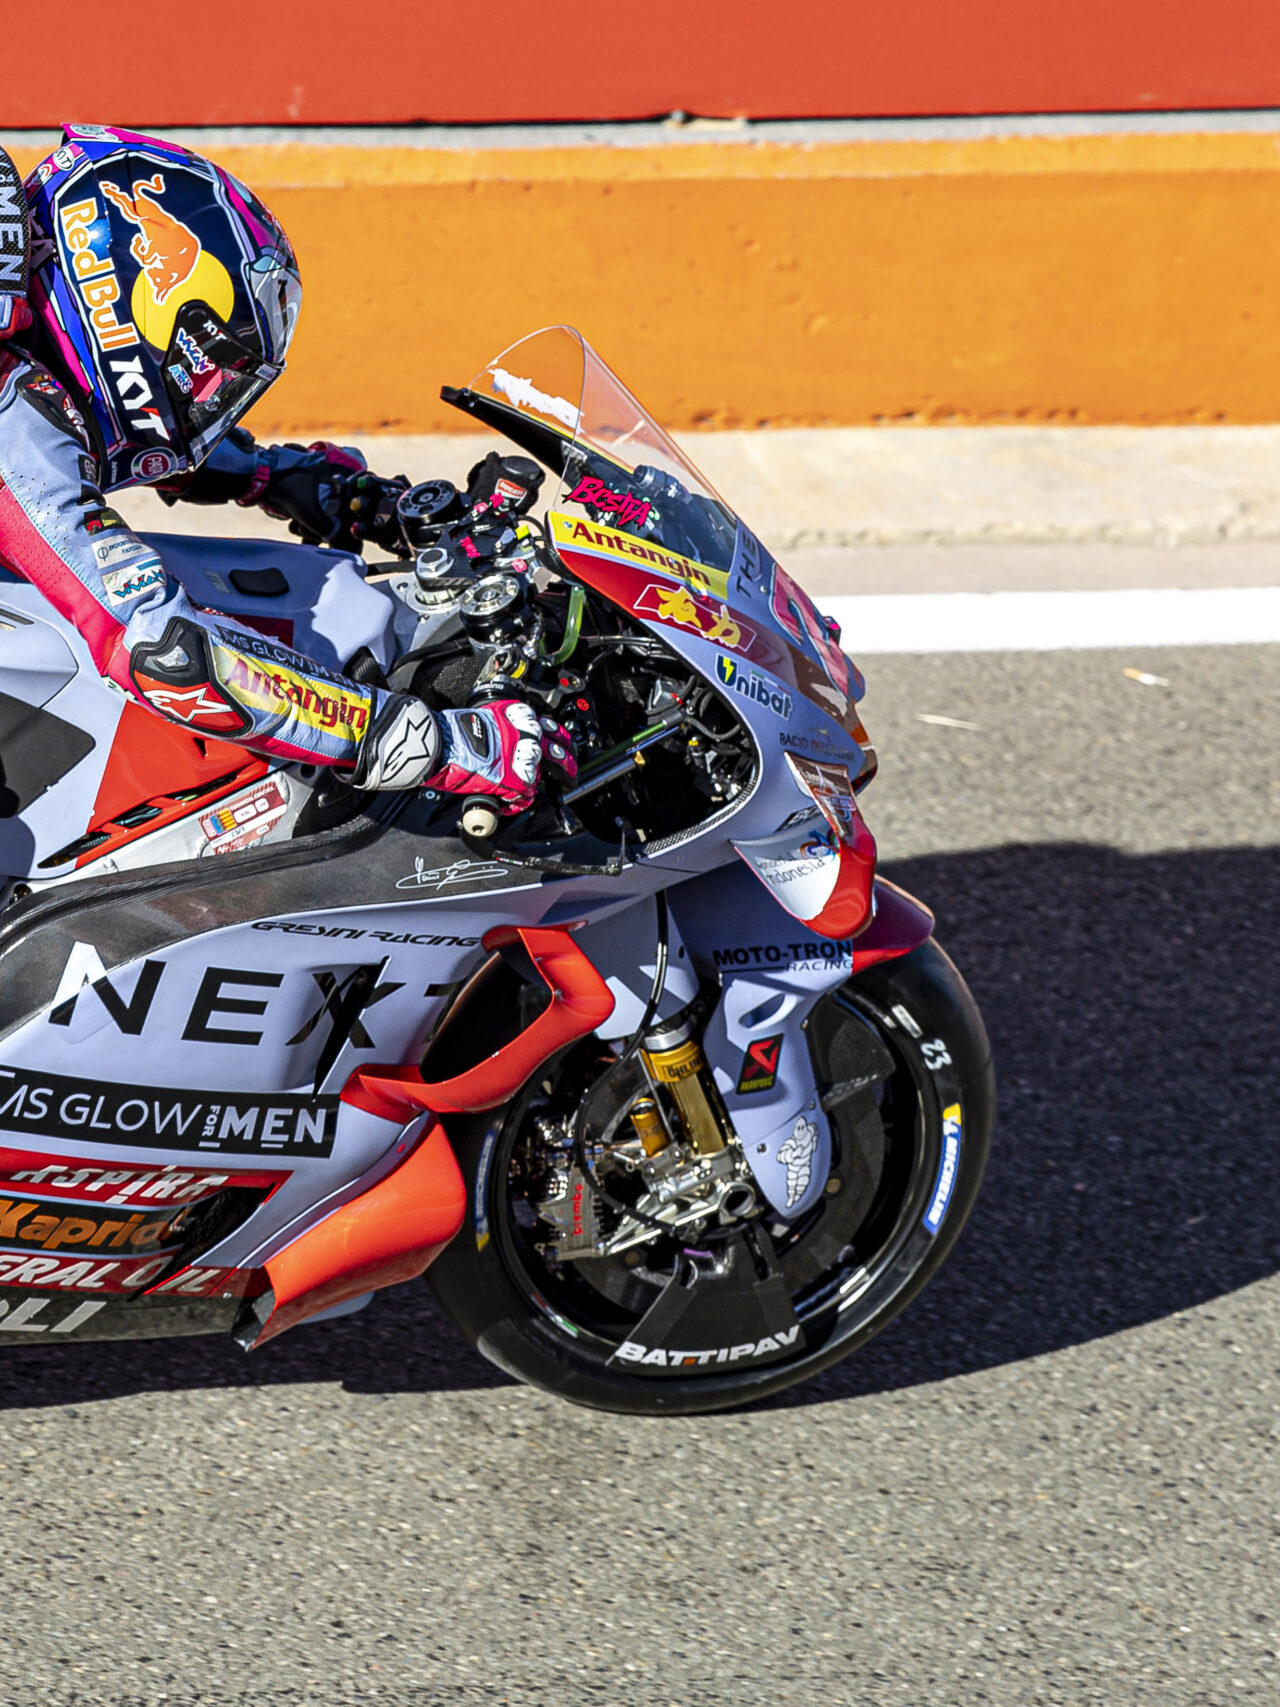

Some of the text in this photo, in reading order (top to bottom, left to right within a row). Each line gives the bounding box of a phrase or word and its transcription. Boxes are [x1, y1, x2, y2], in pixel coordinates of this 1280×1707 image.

[572, 522, 711, 586] Antangin
[223, 658, 368, 729] Antangin
[716, 653, 794, 721] Unibat
[251, 921, 483, 947] GRESINI RACING
[712, 940, 853, 966] MOTO-TRON
[785, 958, 853, 972] RACING
[920, 1038, 953, 1071] 23
[58, 1091, 202, 1138] GLOW
[201, 1103, 220, 1140] FOR
[218, 1105, 329, 1146] MEN
[10, 1163, 230, 1205] ASPIRA
[927, 1136, 959, 1227] MICHELIN
[120, 1255, 221, 1294] OIL
